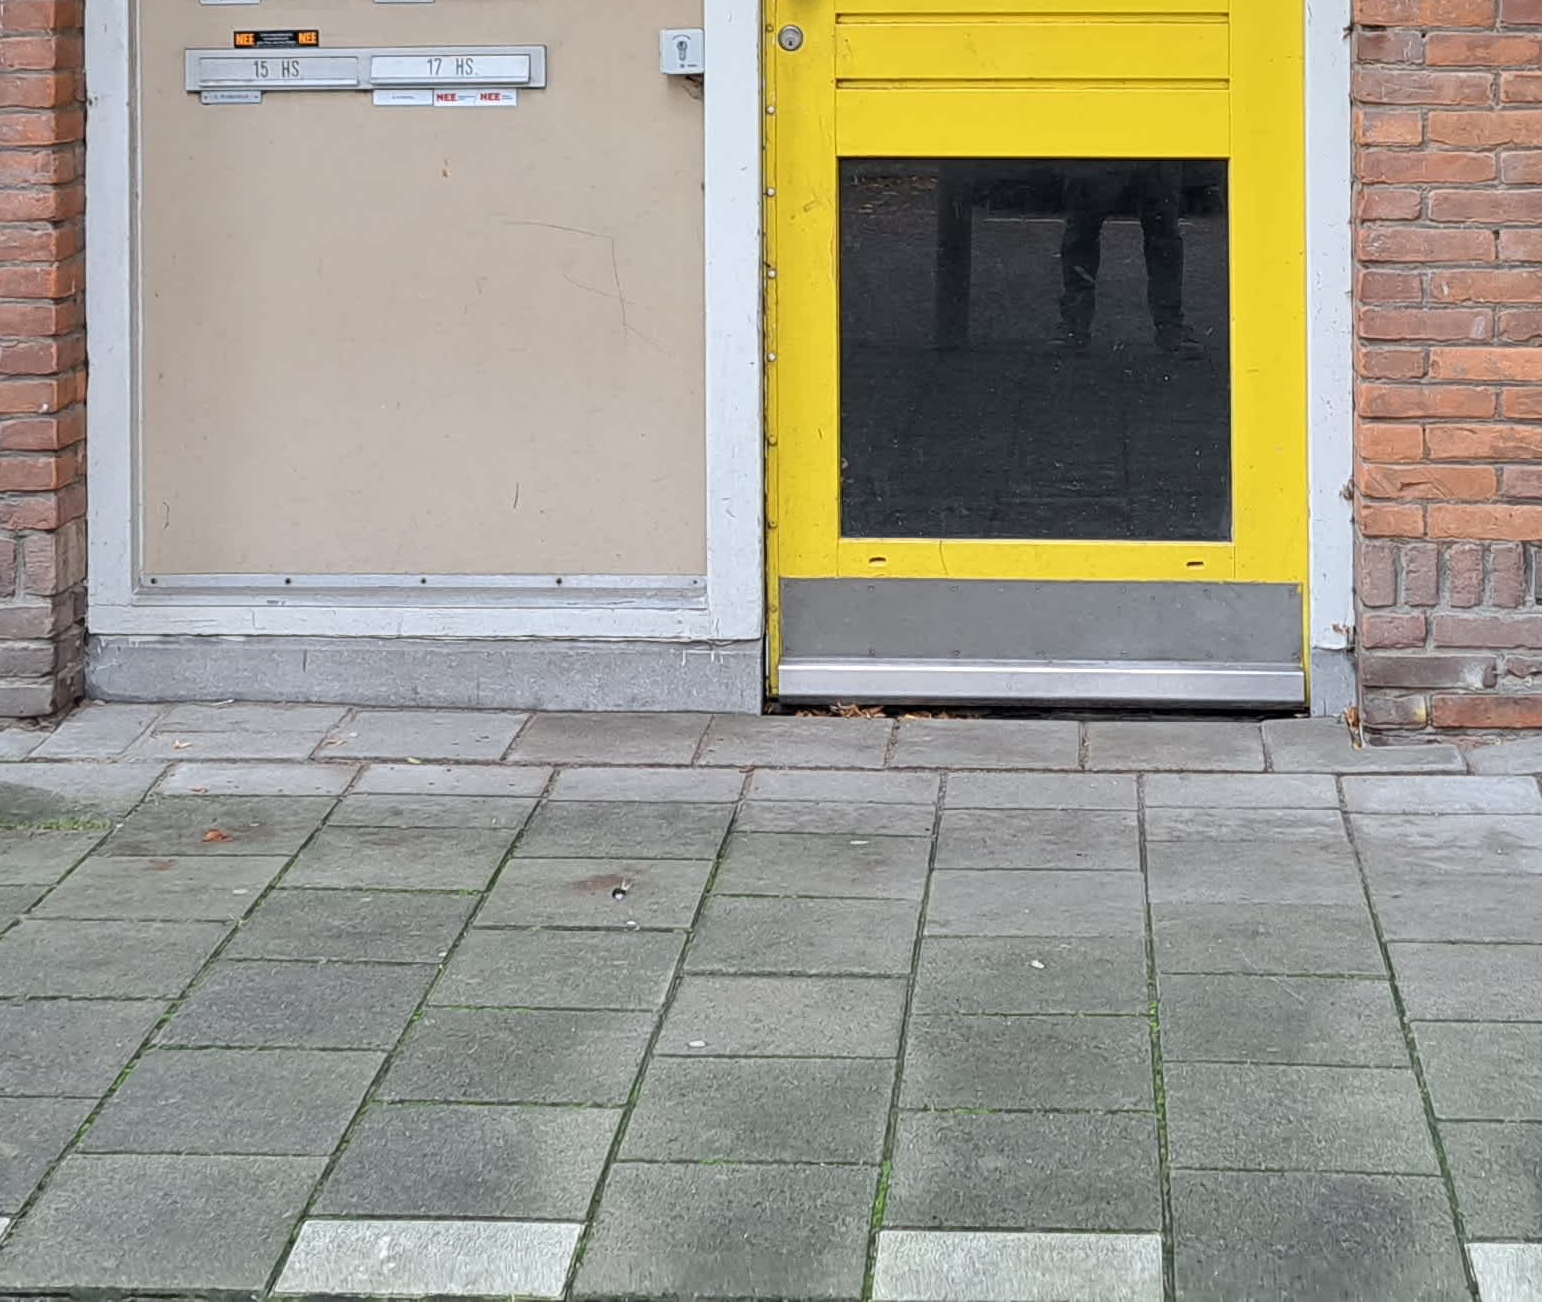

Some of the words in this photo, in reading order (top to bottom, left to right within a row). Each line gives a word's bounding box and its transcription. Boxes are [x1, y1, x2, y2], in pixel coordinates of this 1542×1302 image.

[235, 33, 256, 46] NEE
[298, 32, 317, 44] NEE
[253, 60, 269, 78] 15
[281, 60, 300, 78] HS
[426, 57, 442, 76] 17
[455, 57, 474, 76] HS
[436, 92, 457, 102] NEE
[479, 92, 501, 101] NEE
